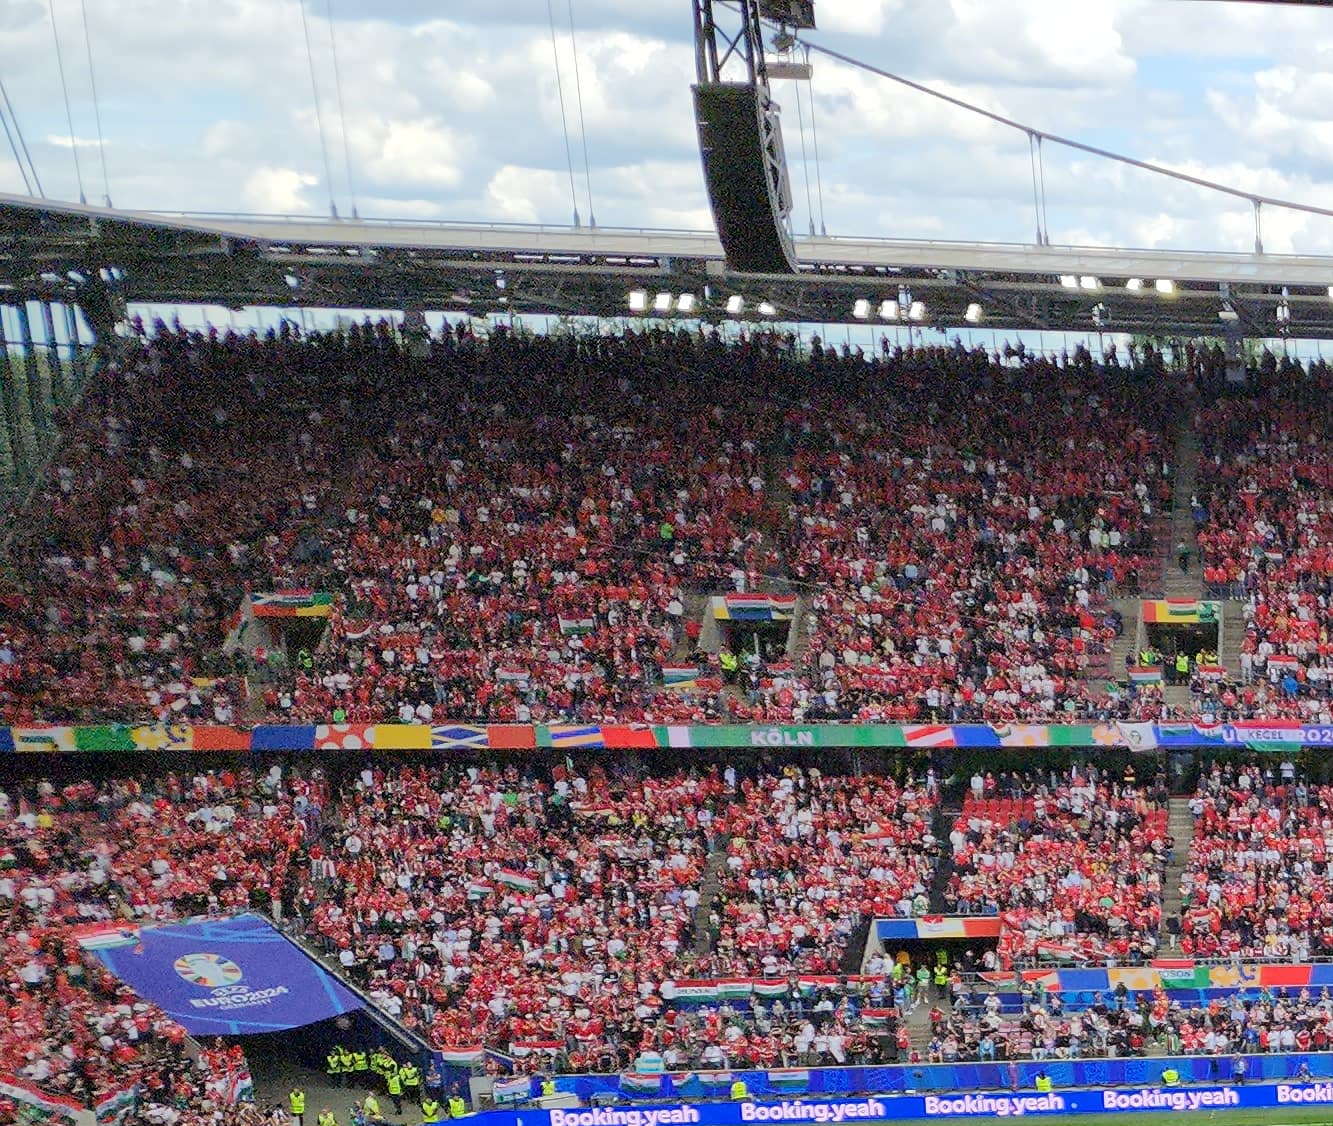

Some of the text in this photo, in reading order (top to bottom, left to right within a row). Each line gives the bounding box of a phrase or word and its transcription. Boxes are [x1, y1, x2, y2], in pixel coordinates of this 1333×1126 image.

[751, 730, 813, 746] KÖLN
[190, 985, 289, 1008] EURO2024
[925, 1091, 1064, 1116] Booking.yeah
[1103, 1087, 1239, 1110] Booking.yeah
[741, 1099, 884, 1122] Booking.yeah
